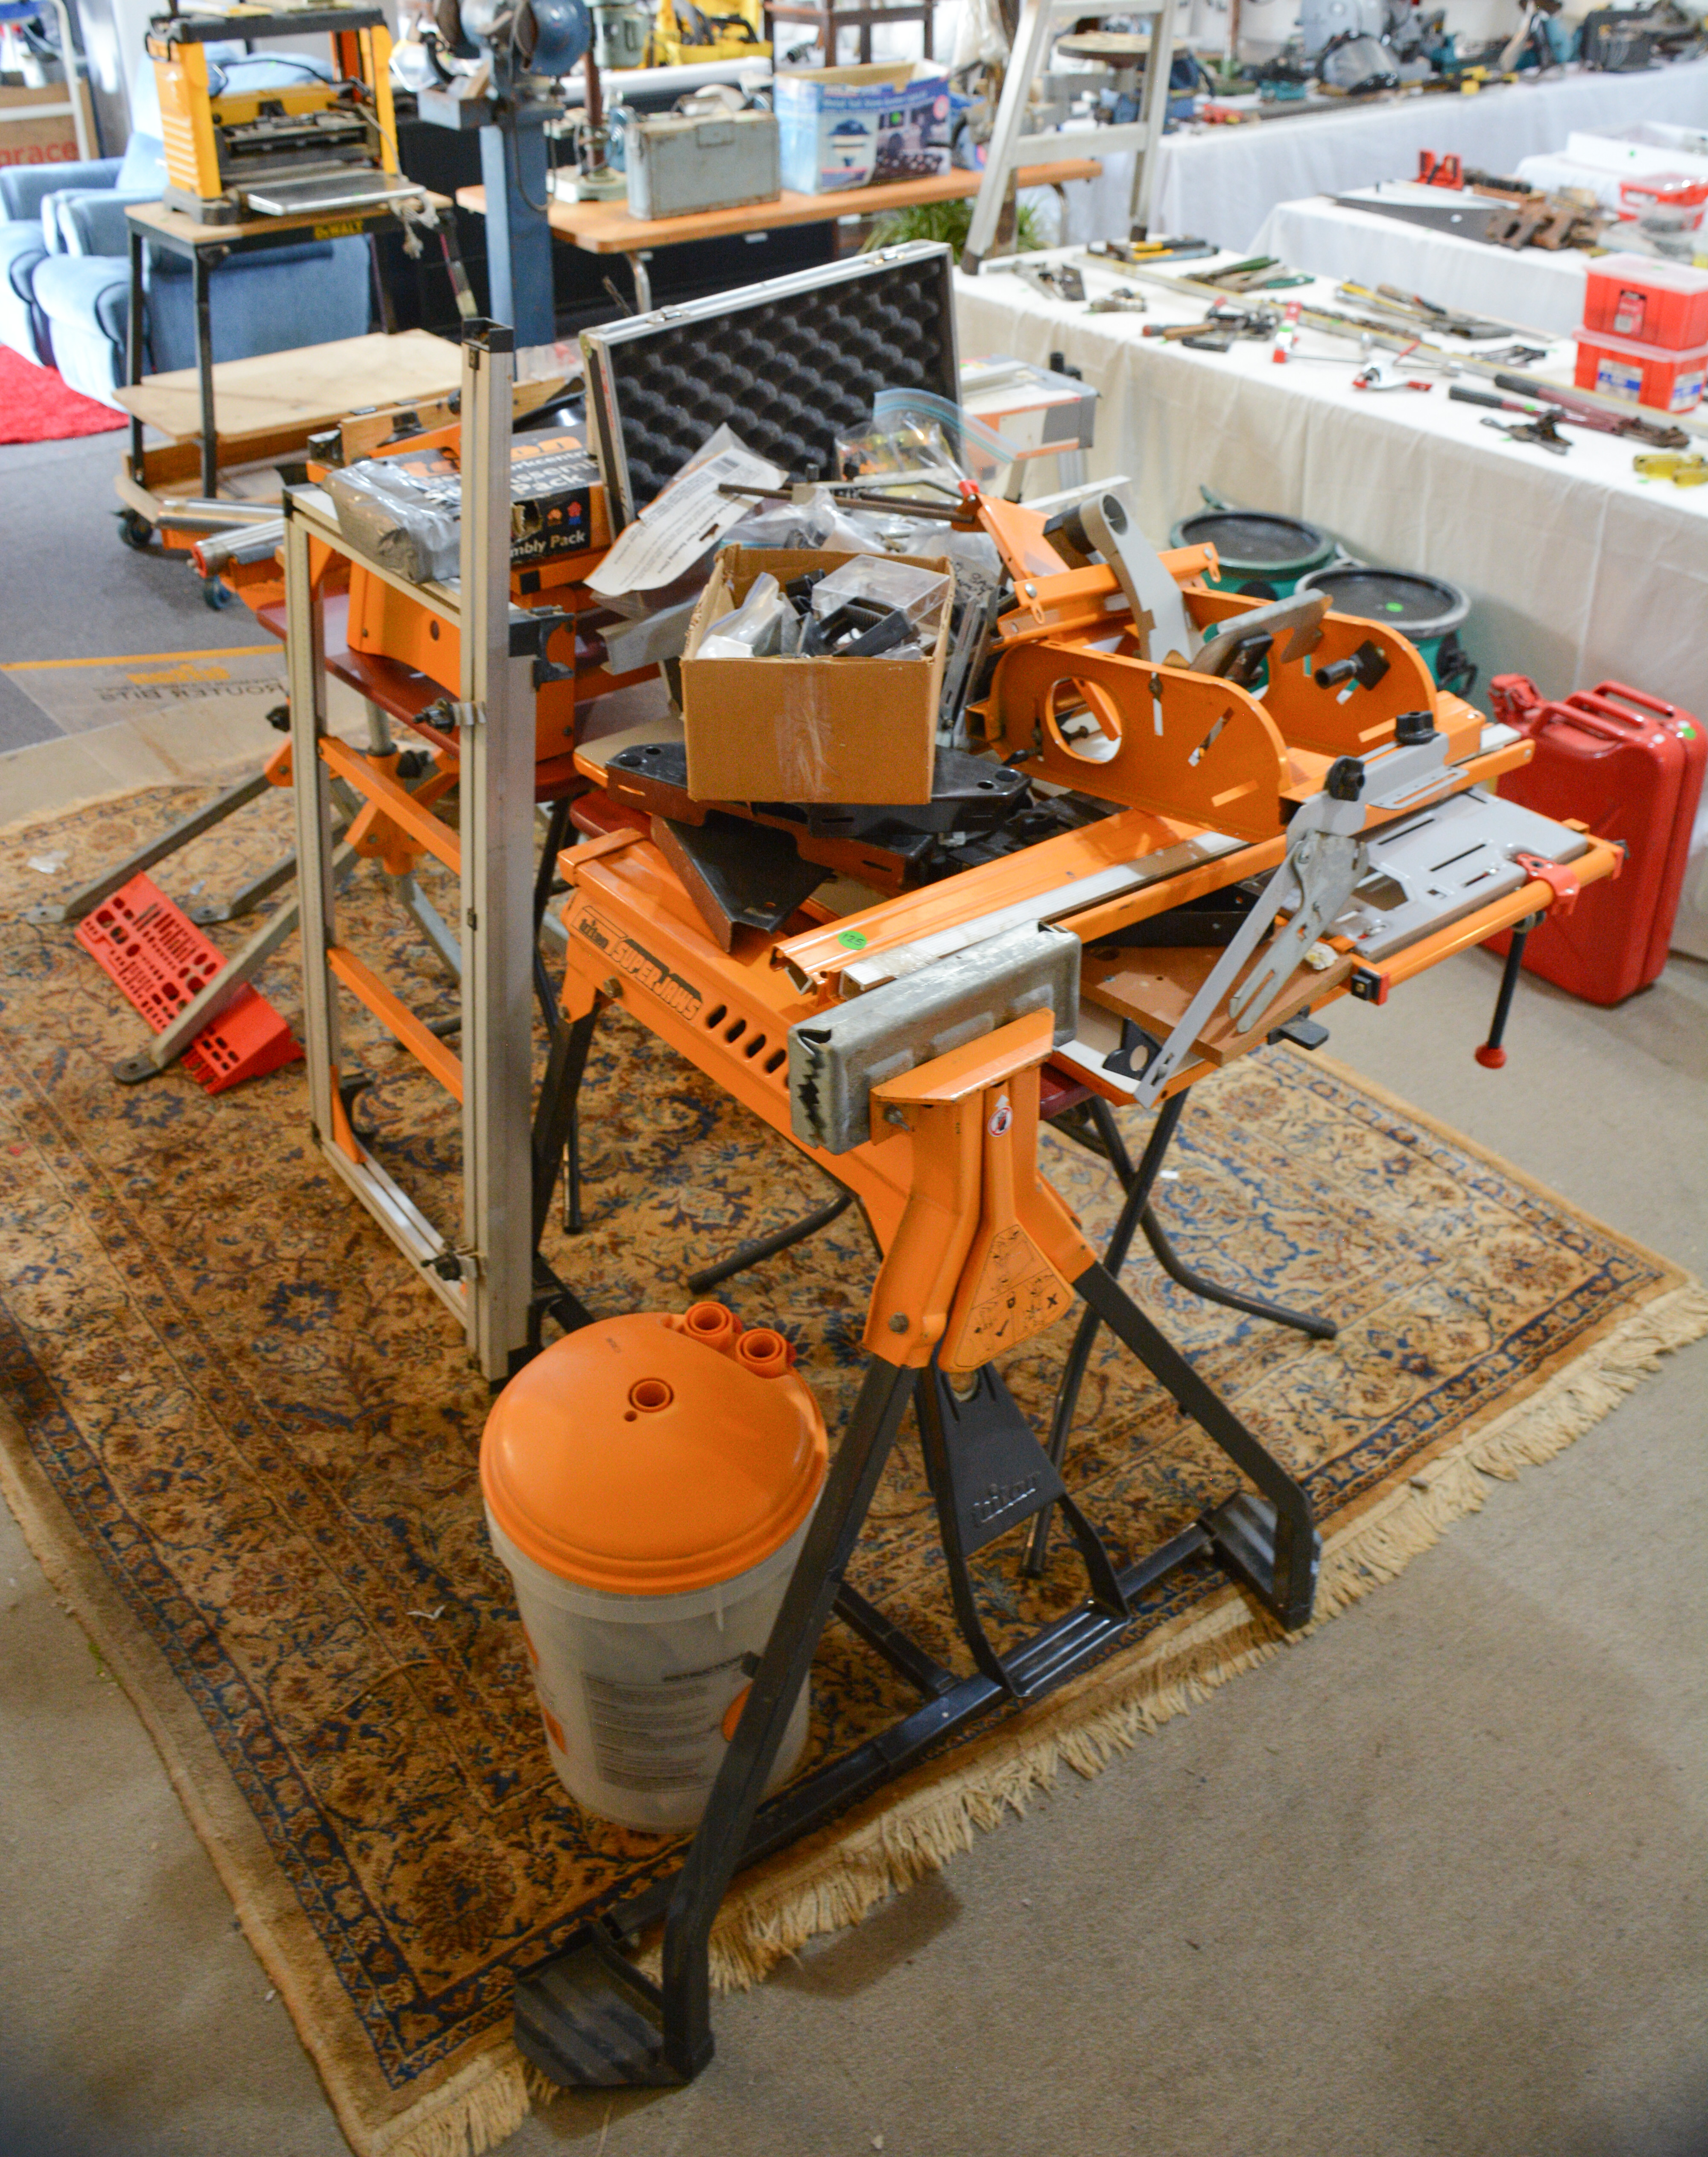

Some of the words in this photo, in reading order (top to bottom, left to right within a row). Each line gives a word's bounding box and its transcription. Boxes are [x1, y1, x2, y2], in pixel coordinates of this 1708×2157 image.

[510, 473, 585, 495] Pack
[511, 539, 546, 558] mbly
[550, 530, 585, 549] Pack
[841, 933, 865, 946] 125
